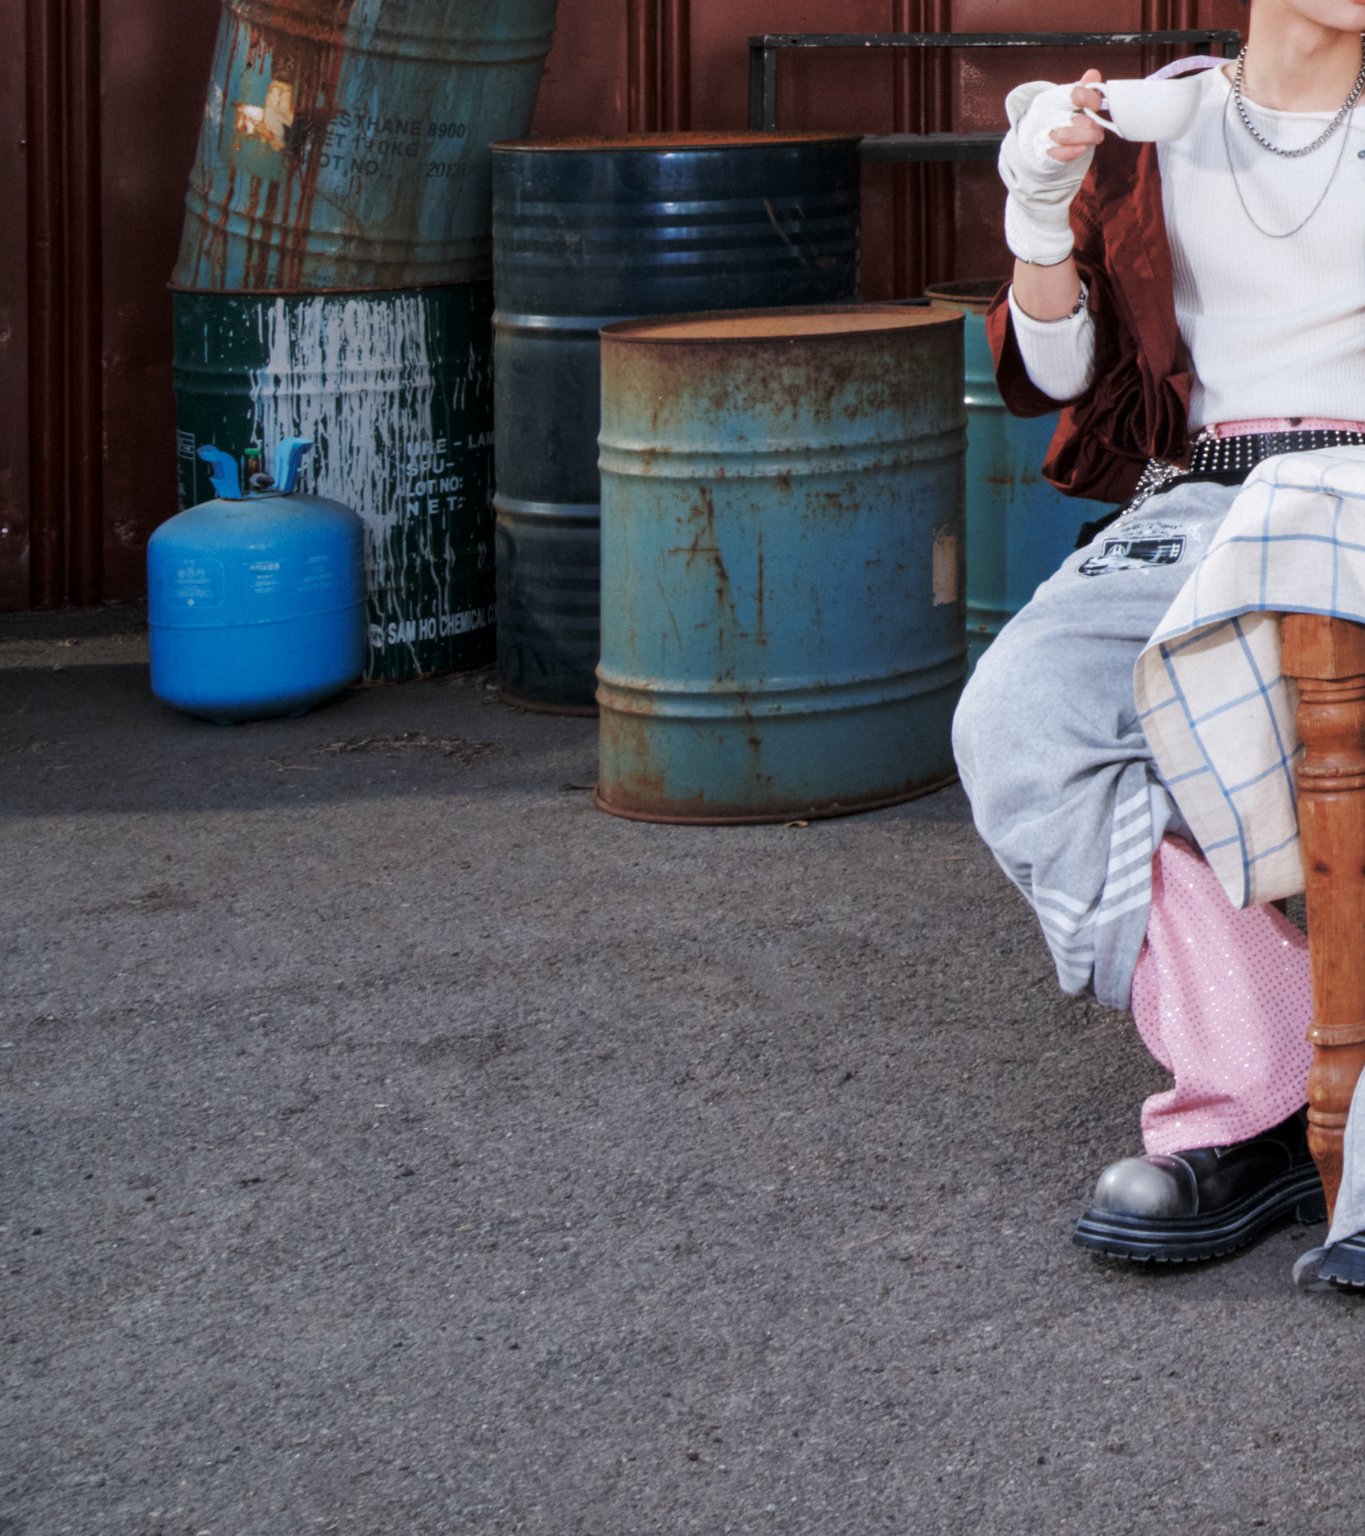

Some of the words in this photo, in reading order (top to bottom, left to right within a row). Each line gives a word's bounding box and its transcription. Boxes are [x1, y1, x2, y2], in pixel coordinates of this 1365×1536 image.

[428, 122, 466, 138] 8900
[388, 619, 417, 645] SAM
[419, 615, 437, 641] HO
[439, 606, 487, 637] CHEMICAL
